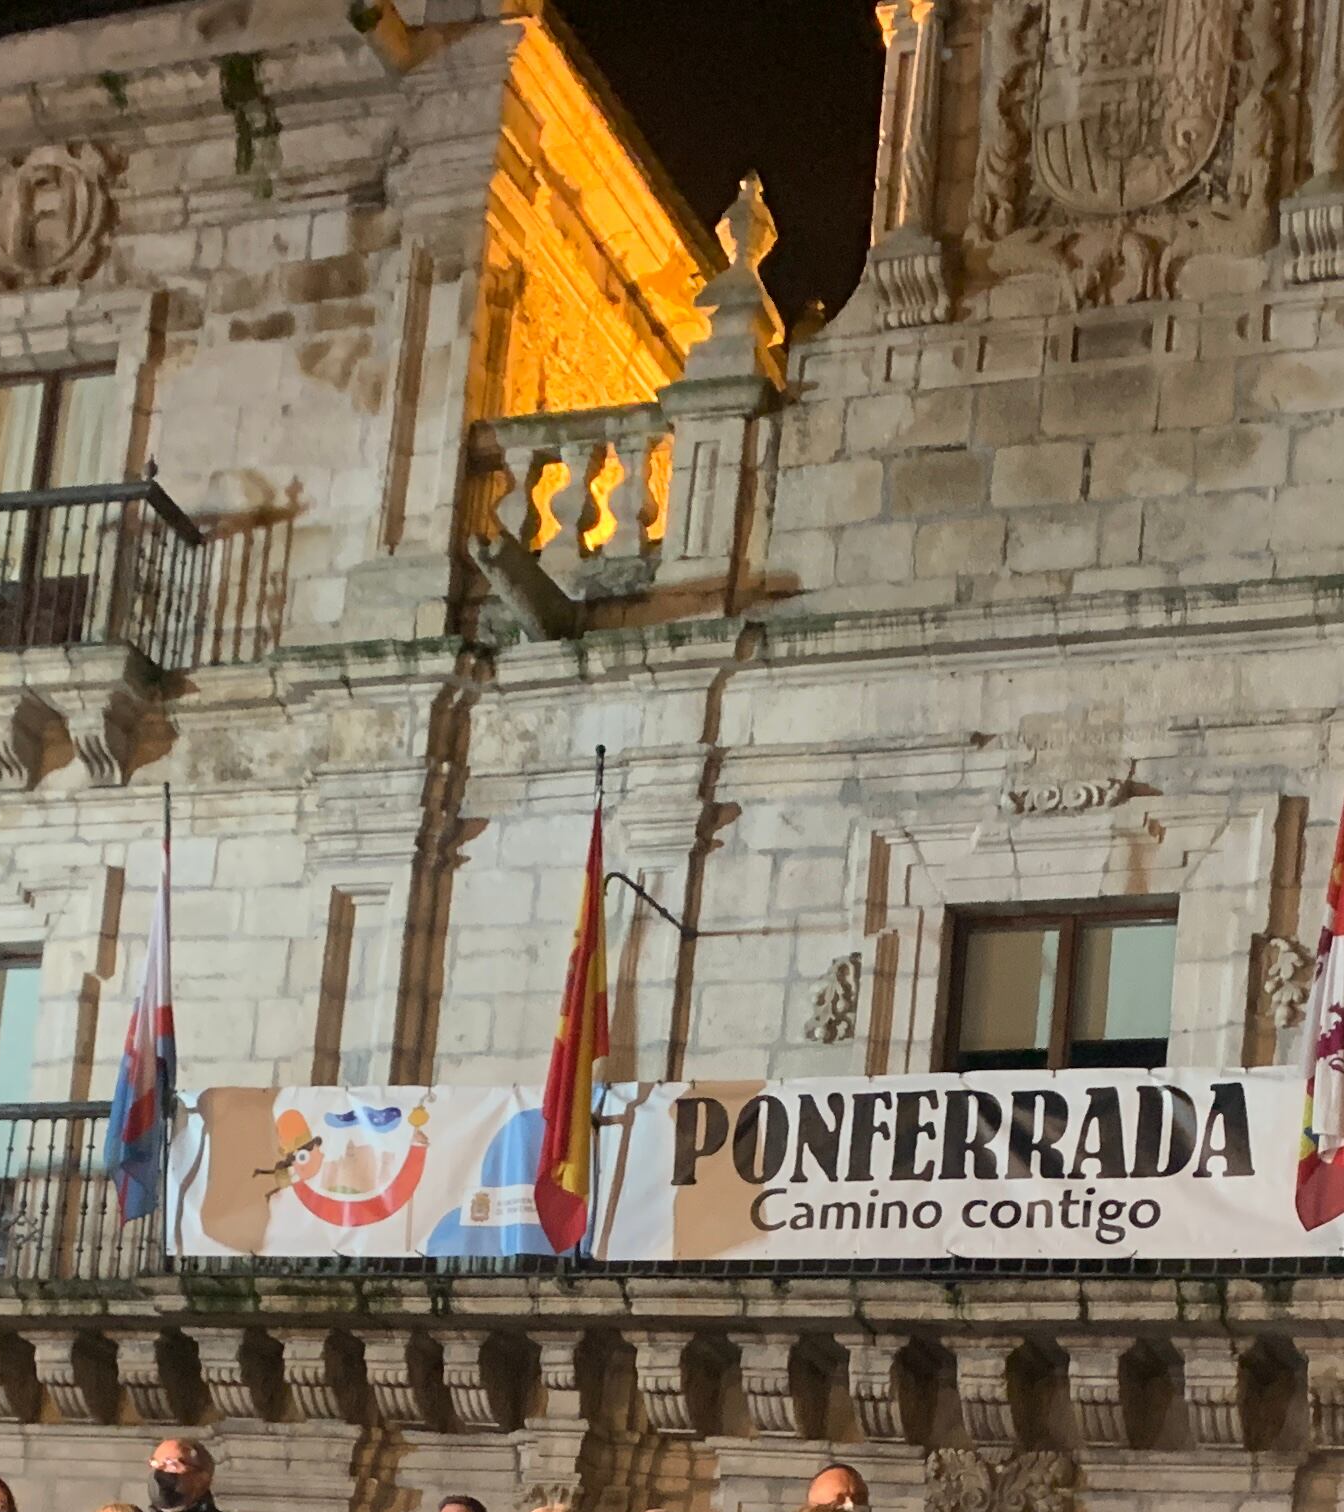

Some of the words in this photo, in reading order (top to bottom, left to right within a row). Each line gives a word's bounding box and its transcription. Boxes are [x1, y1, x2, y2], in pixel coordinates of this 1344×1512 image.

[671, 1082, 1255, 1185] PONFERRADA
[750, 1187, 943, 1231] Camino
[961, 1187, 1161, 1245] contigo
